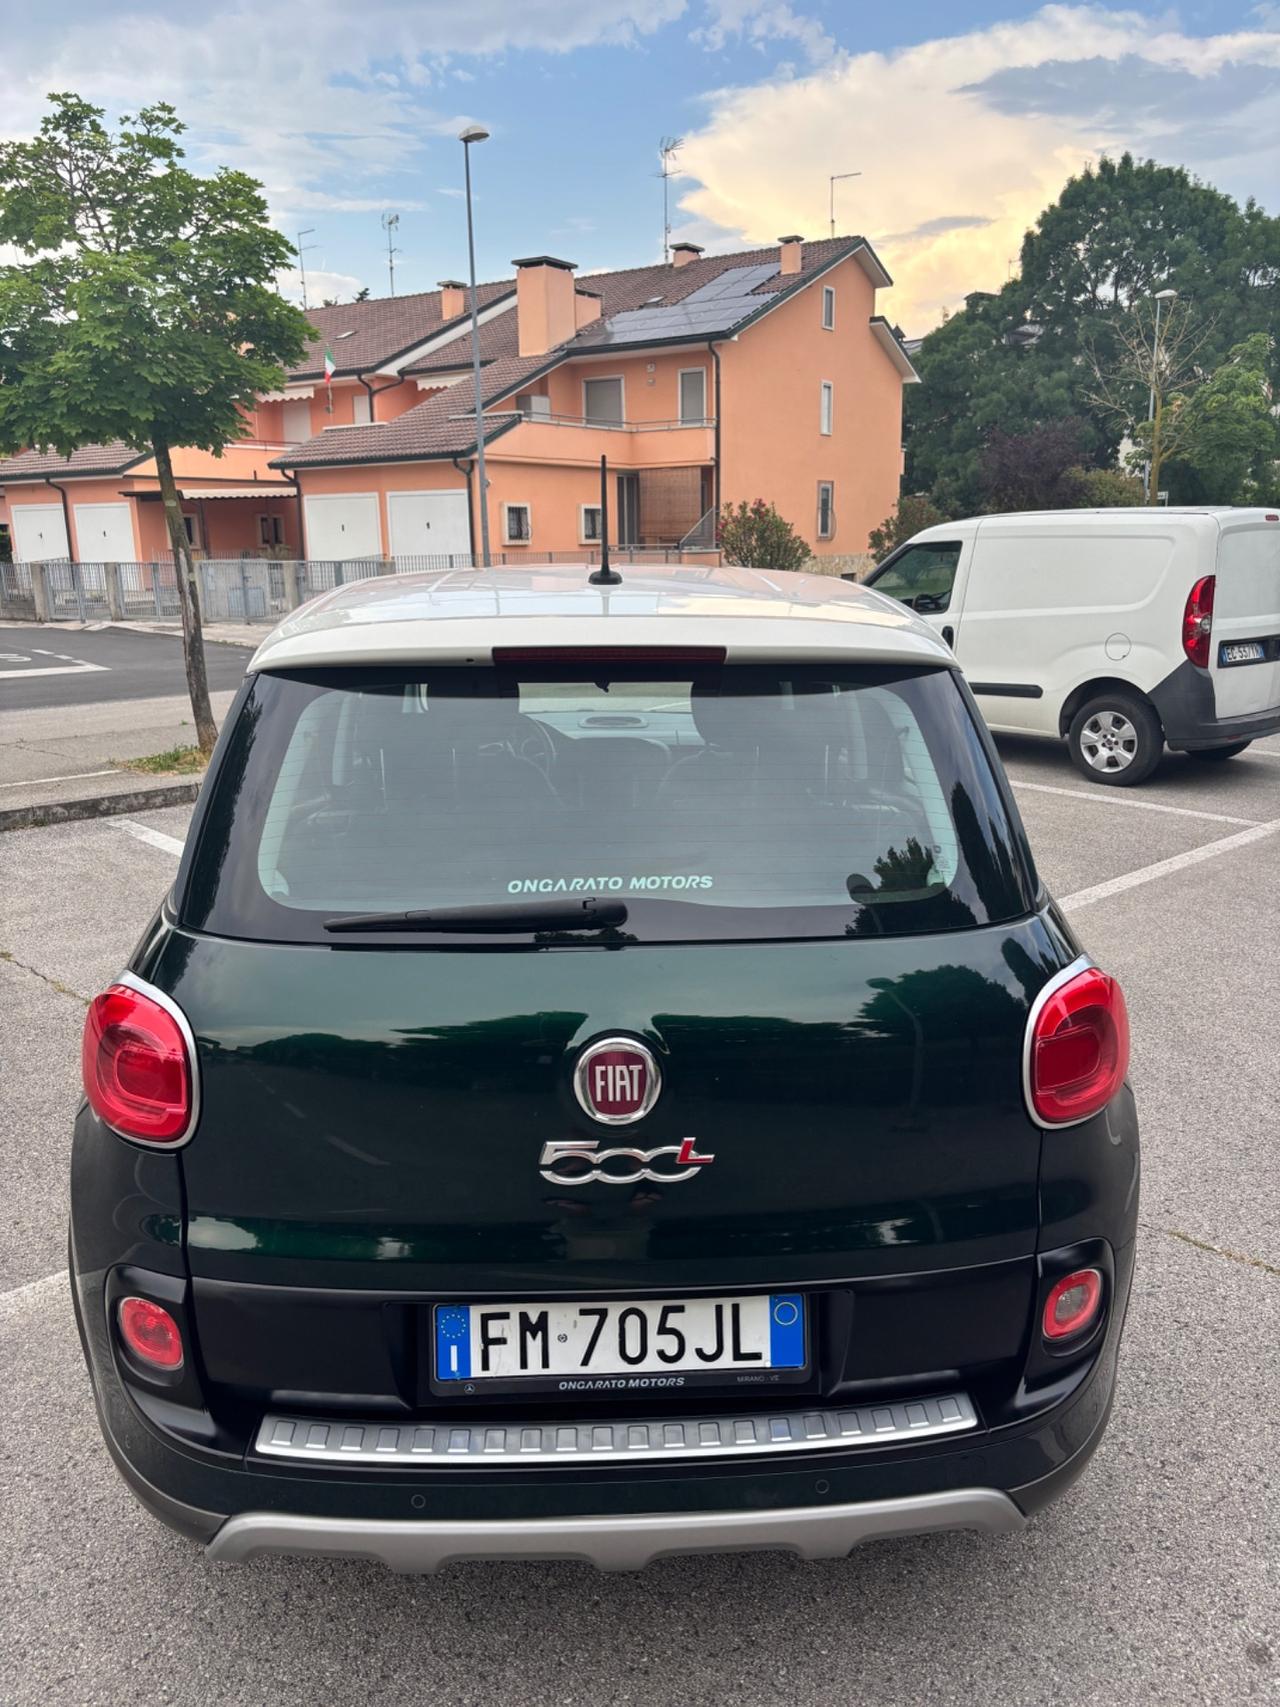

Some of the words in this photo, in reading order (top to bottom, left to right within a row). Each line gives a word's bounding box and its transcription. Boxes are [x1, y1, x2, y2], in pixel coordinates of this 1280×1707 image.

[507, 877, 623, 893] ONGARATO
[630, 875, 713, 890] MOTORS
[595, 1064, 643, 1102] FIAT
[539, 1137, 715, 1185] 500L
[480, 1310, 549, 1372] FM
[578, 1302, 763, 1367] 705JL
[559, 1379, 625, 1390] ONGARATO
[628, 1377, 685, 1388] MOTORS
